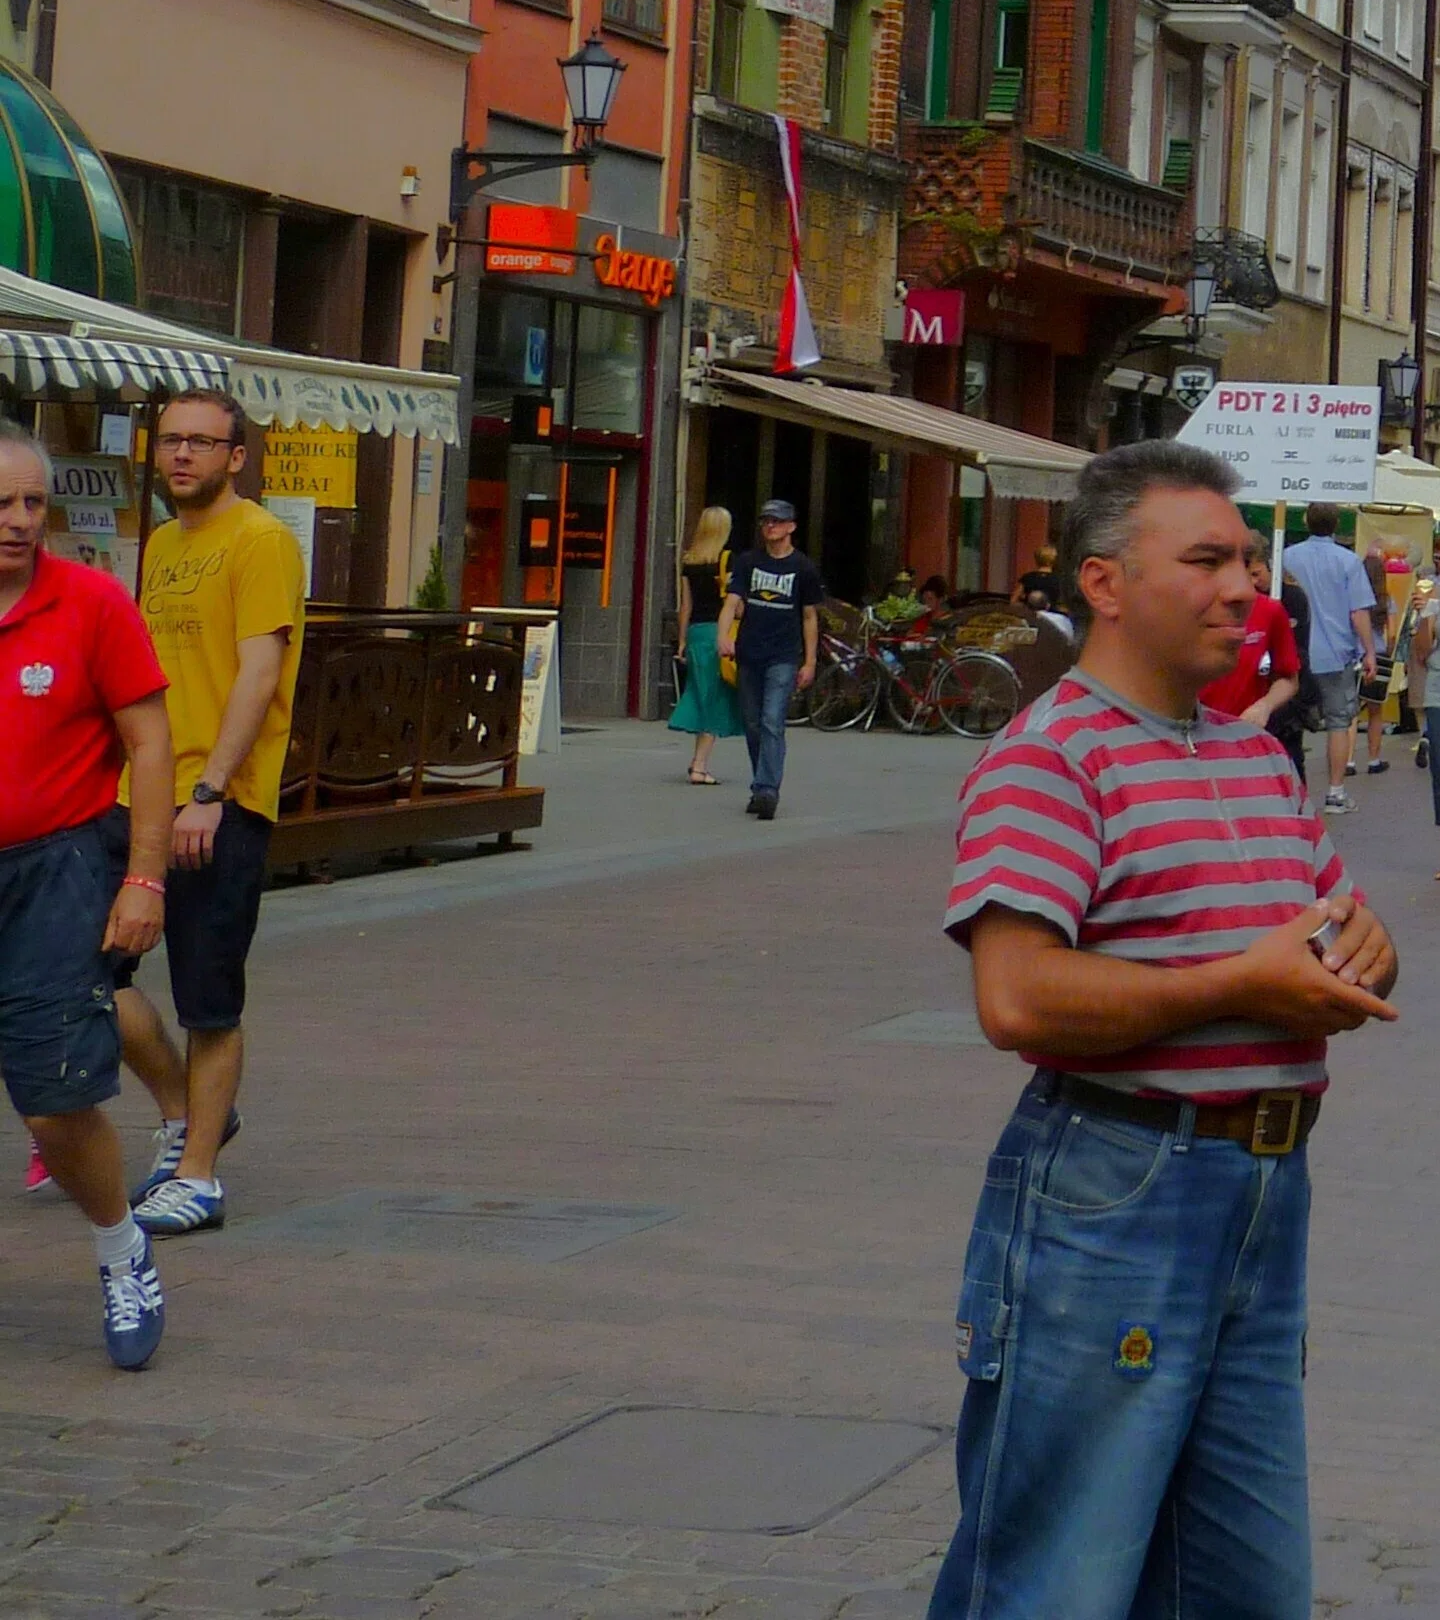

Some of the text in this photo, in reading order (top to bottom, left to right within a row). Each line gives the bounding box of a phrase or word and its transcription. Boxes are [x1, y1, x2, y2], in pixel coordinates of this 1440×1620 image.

[490, 252, 543, 270] orange
[908, 308, 943, 345] M
[1218, 391, 1373, 418] PDT 2 i 3 piętro
[1206, 423, 1255, 437] FURLA
[260, 476, 333, 492] RABAT
[1281, 477, 1311, 491] D&G
